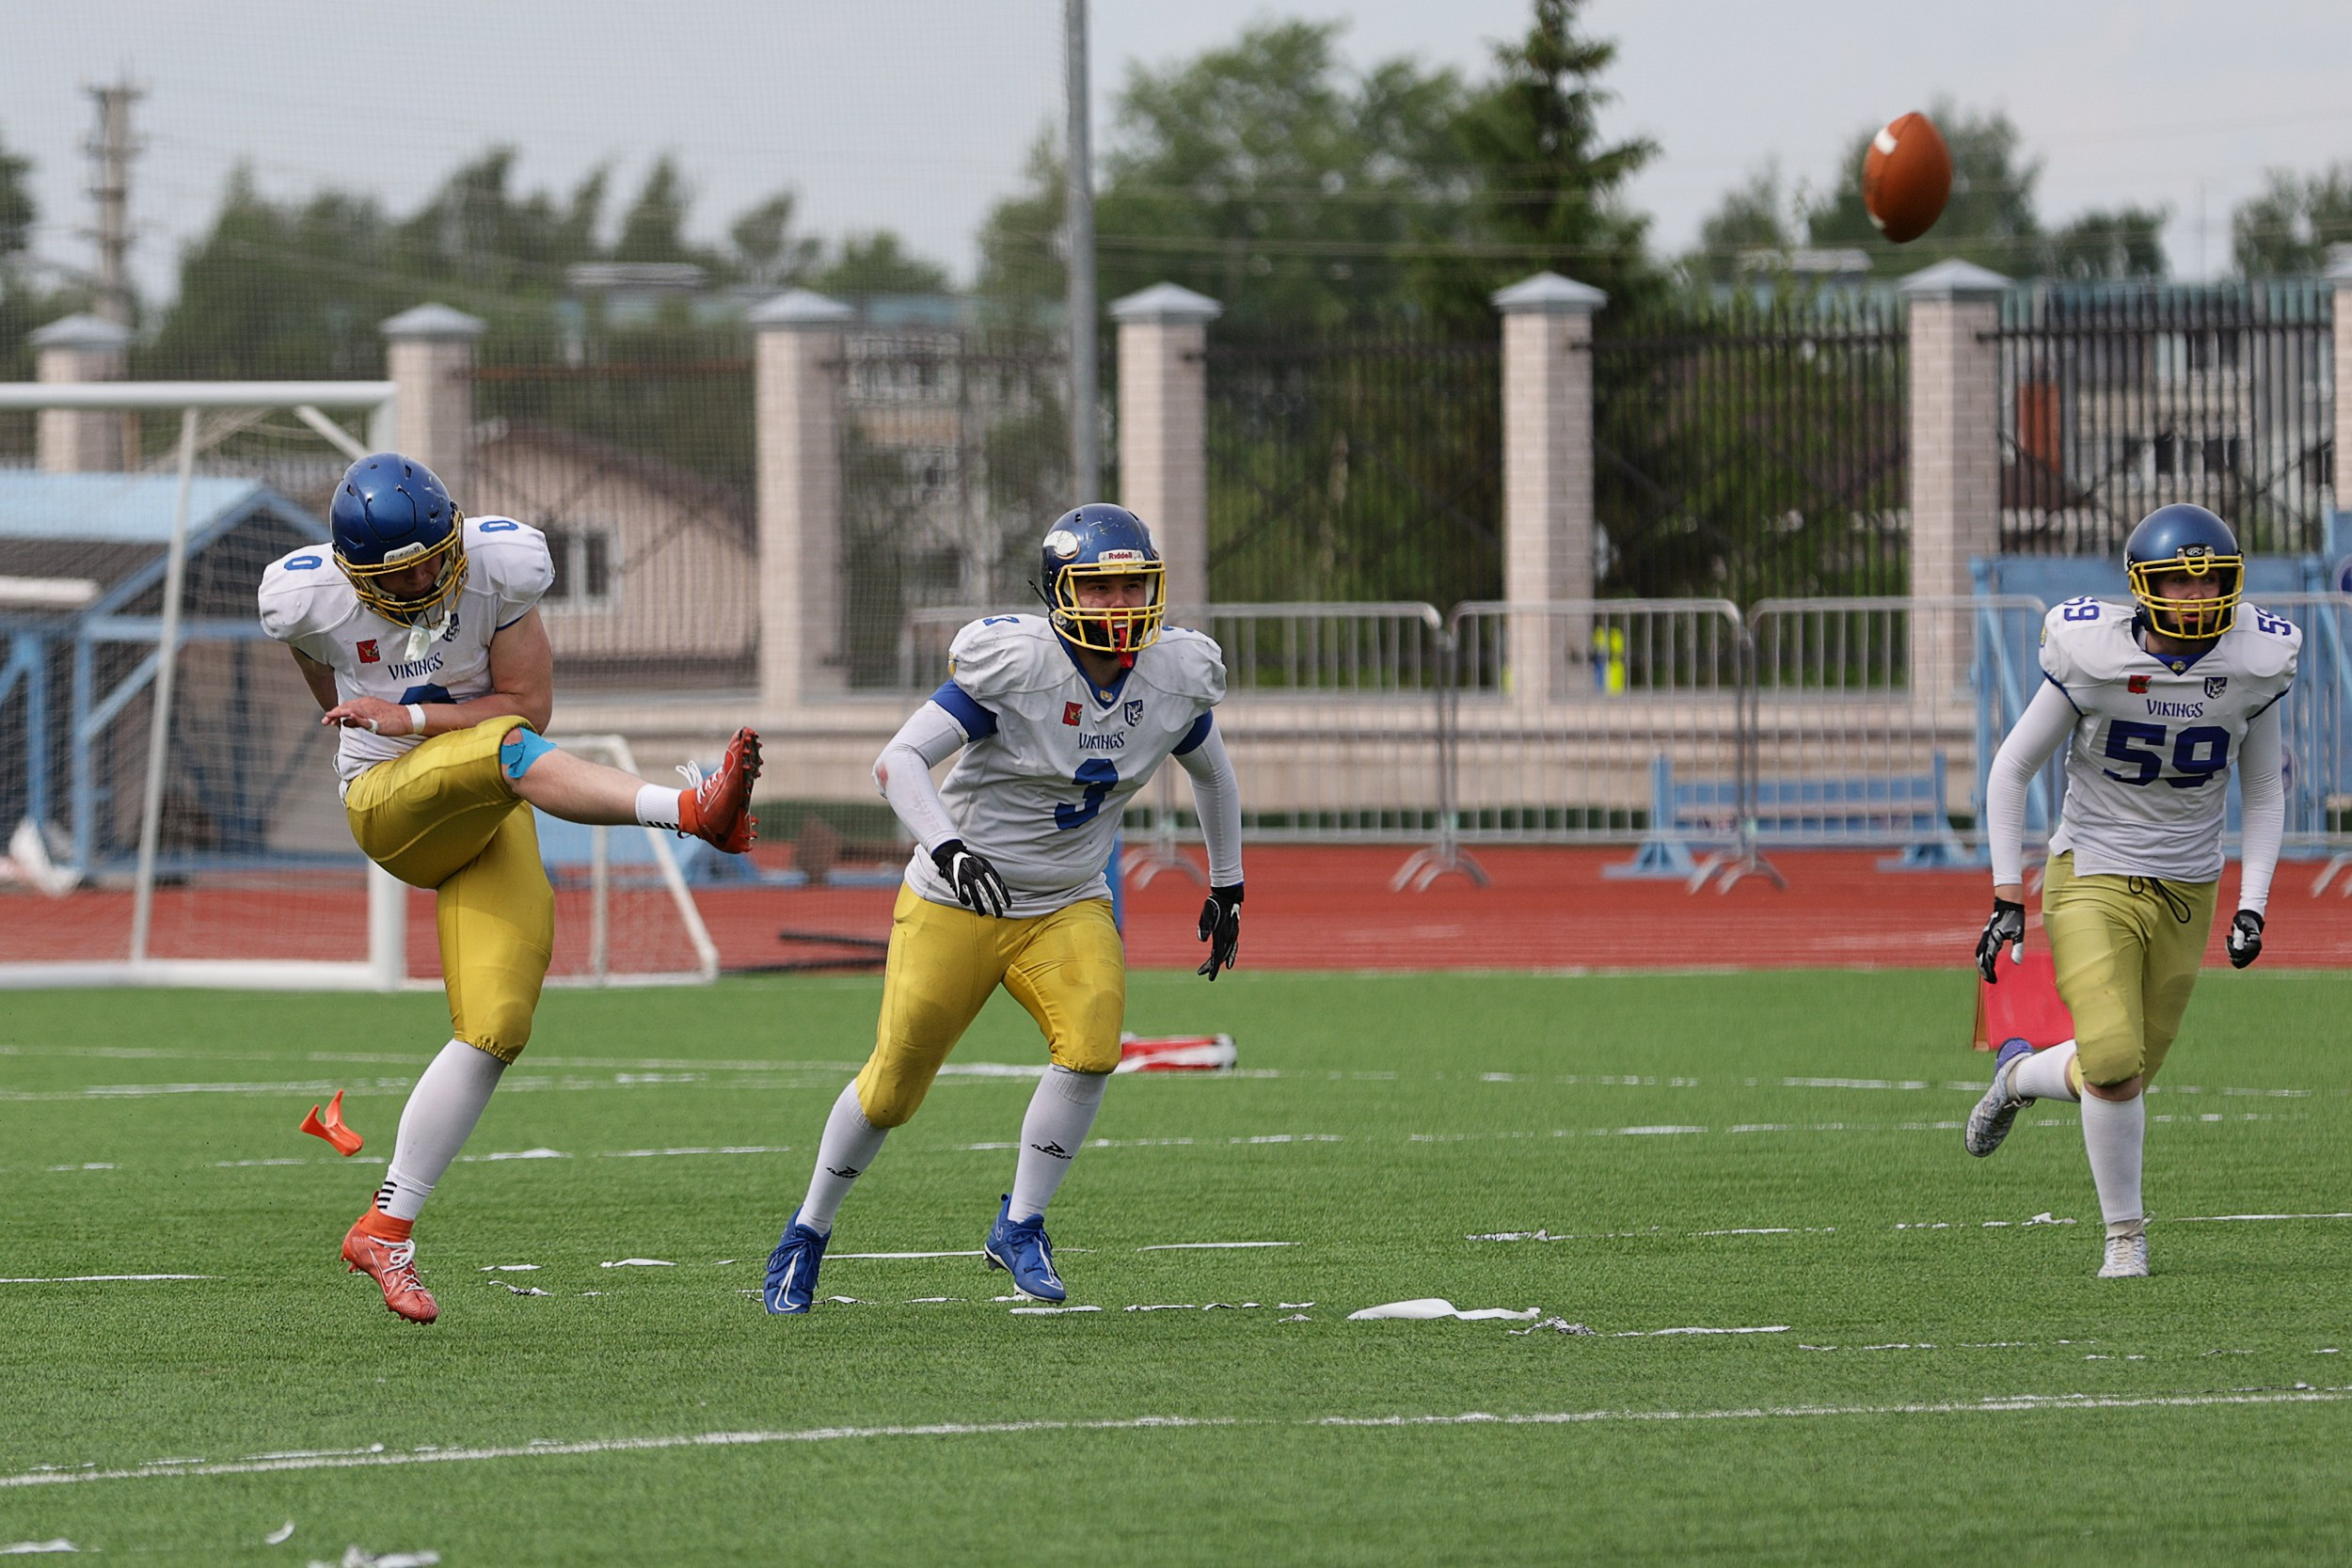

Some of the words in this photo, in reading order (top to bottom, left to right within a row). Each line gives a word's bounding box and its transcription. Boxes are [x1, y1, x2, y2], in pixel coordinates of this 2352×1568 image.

[479, 520, 519, 532] 0
[283, 555, 323, 571] 0
[1108, 551, 1134, 560] Riddell
[388, 652, 444, 681] VIKINGS
[2146, 699, 2203, 719] VIKINGS
[1078, 731, 1125, 750] VIKINGS
[2103, 719, 2231, 789] 59
[1053, 758, 1120, 831] 3
